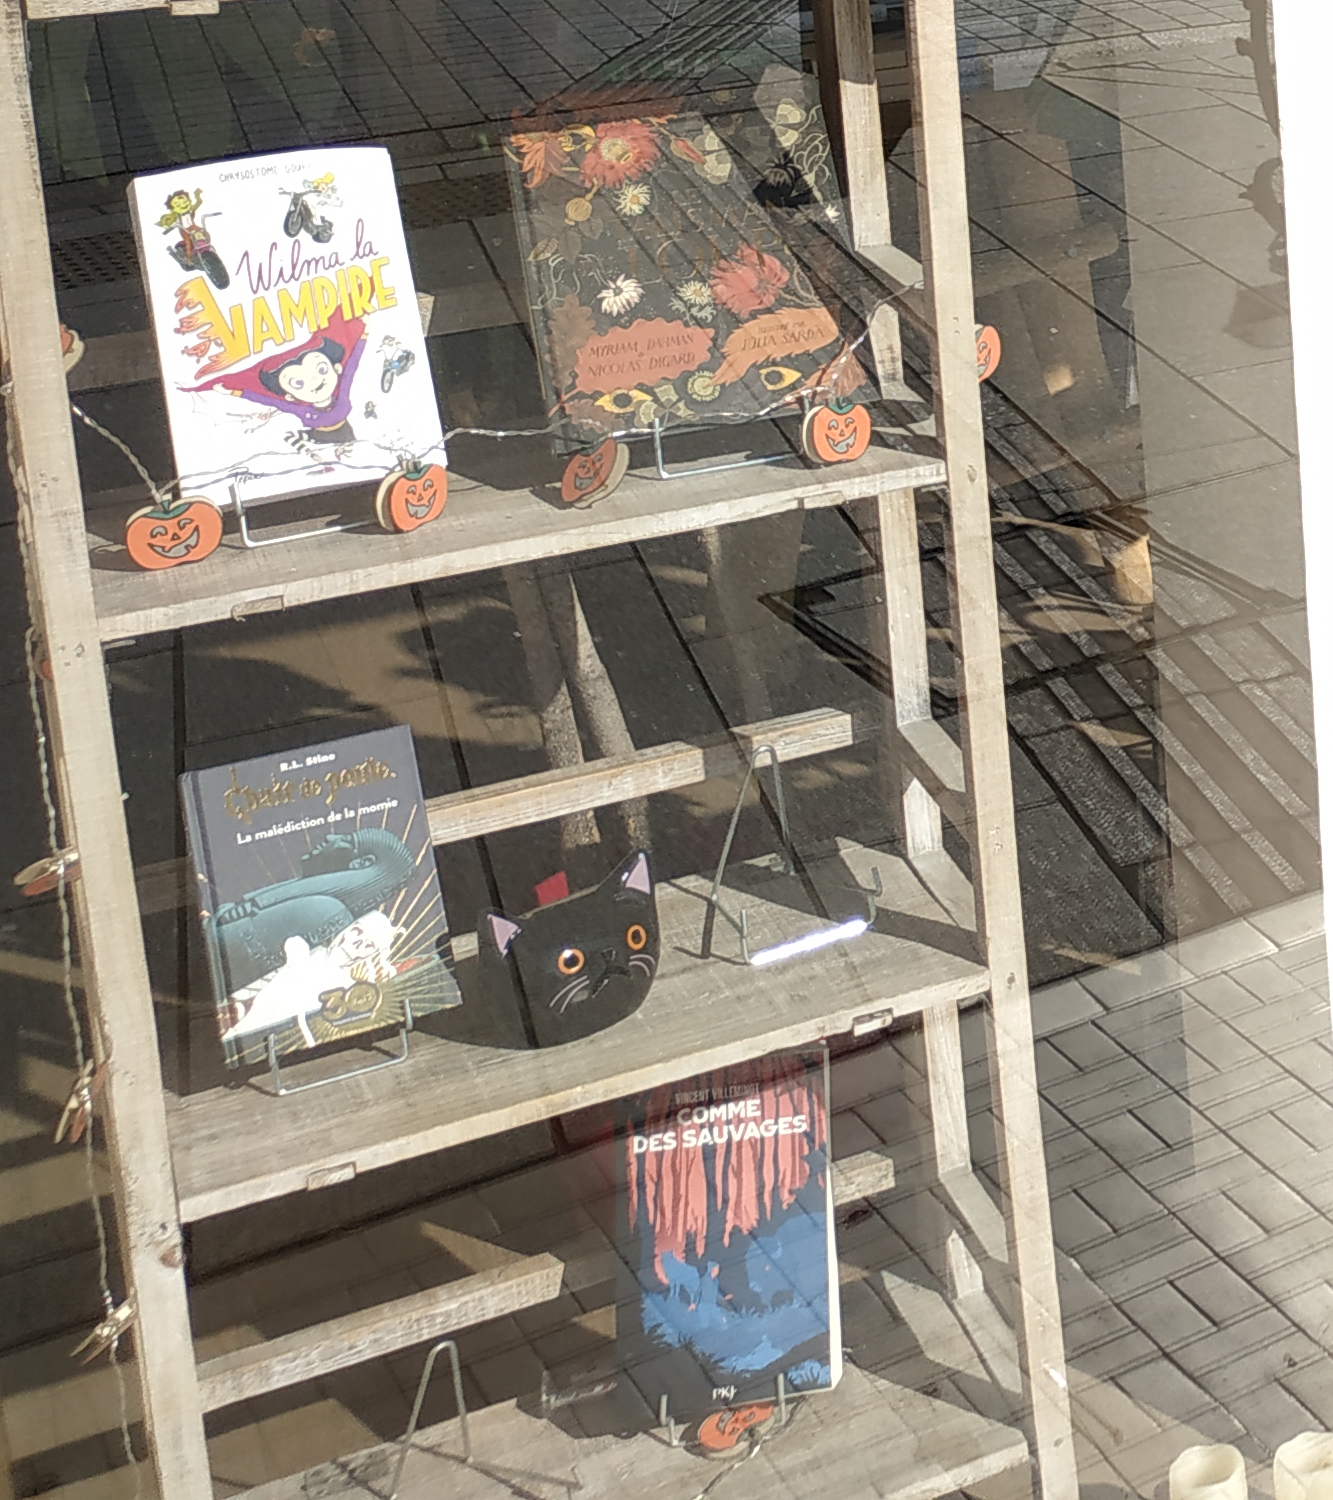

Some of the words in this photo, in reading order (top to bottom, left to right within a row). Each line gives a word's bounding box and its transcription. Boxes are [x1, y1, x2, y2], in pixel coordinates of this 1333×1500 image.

[218, 165, 278, 182] CHRYSOSTOME
[235, 238, 345, 294] Wilma
[350, 218, 379, 262] la
[174, 256, 398, 380] VAMPIRE
[588, 361, 642, 377] NICOLAS
[649, 352, 696, 370] DIGARD
[279, 760, 304, 772] R.L.
[237, 832, 253, 845] La
[255, 817, 325, 841] malédiction
[327, 810, 343, 823] de
[344, 807, 356, 819] la
[359, 797, 399, 817] momie
[677, 1099, 761, 1126] COMME
[634, 1131, 677, 1155] DES
[683, 1115, 808, 1148] SAUVAGES
